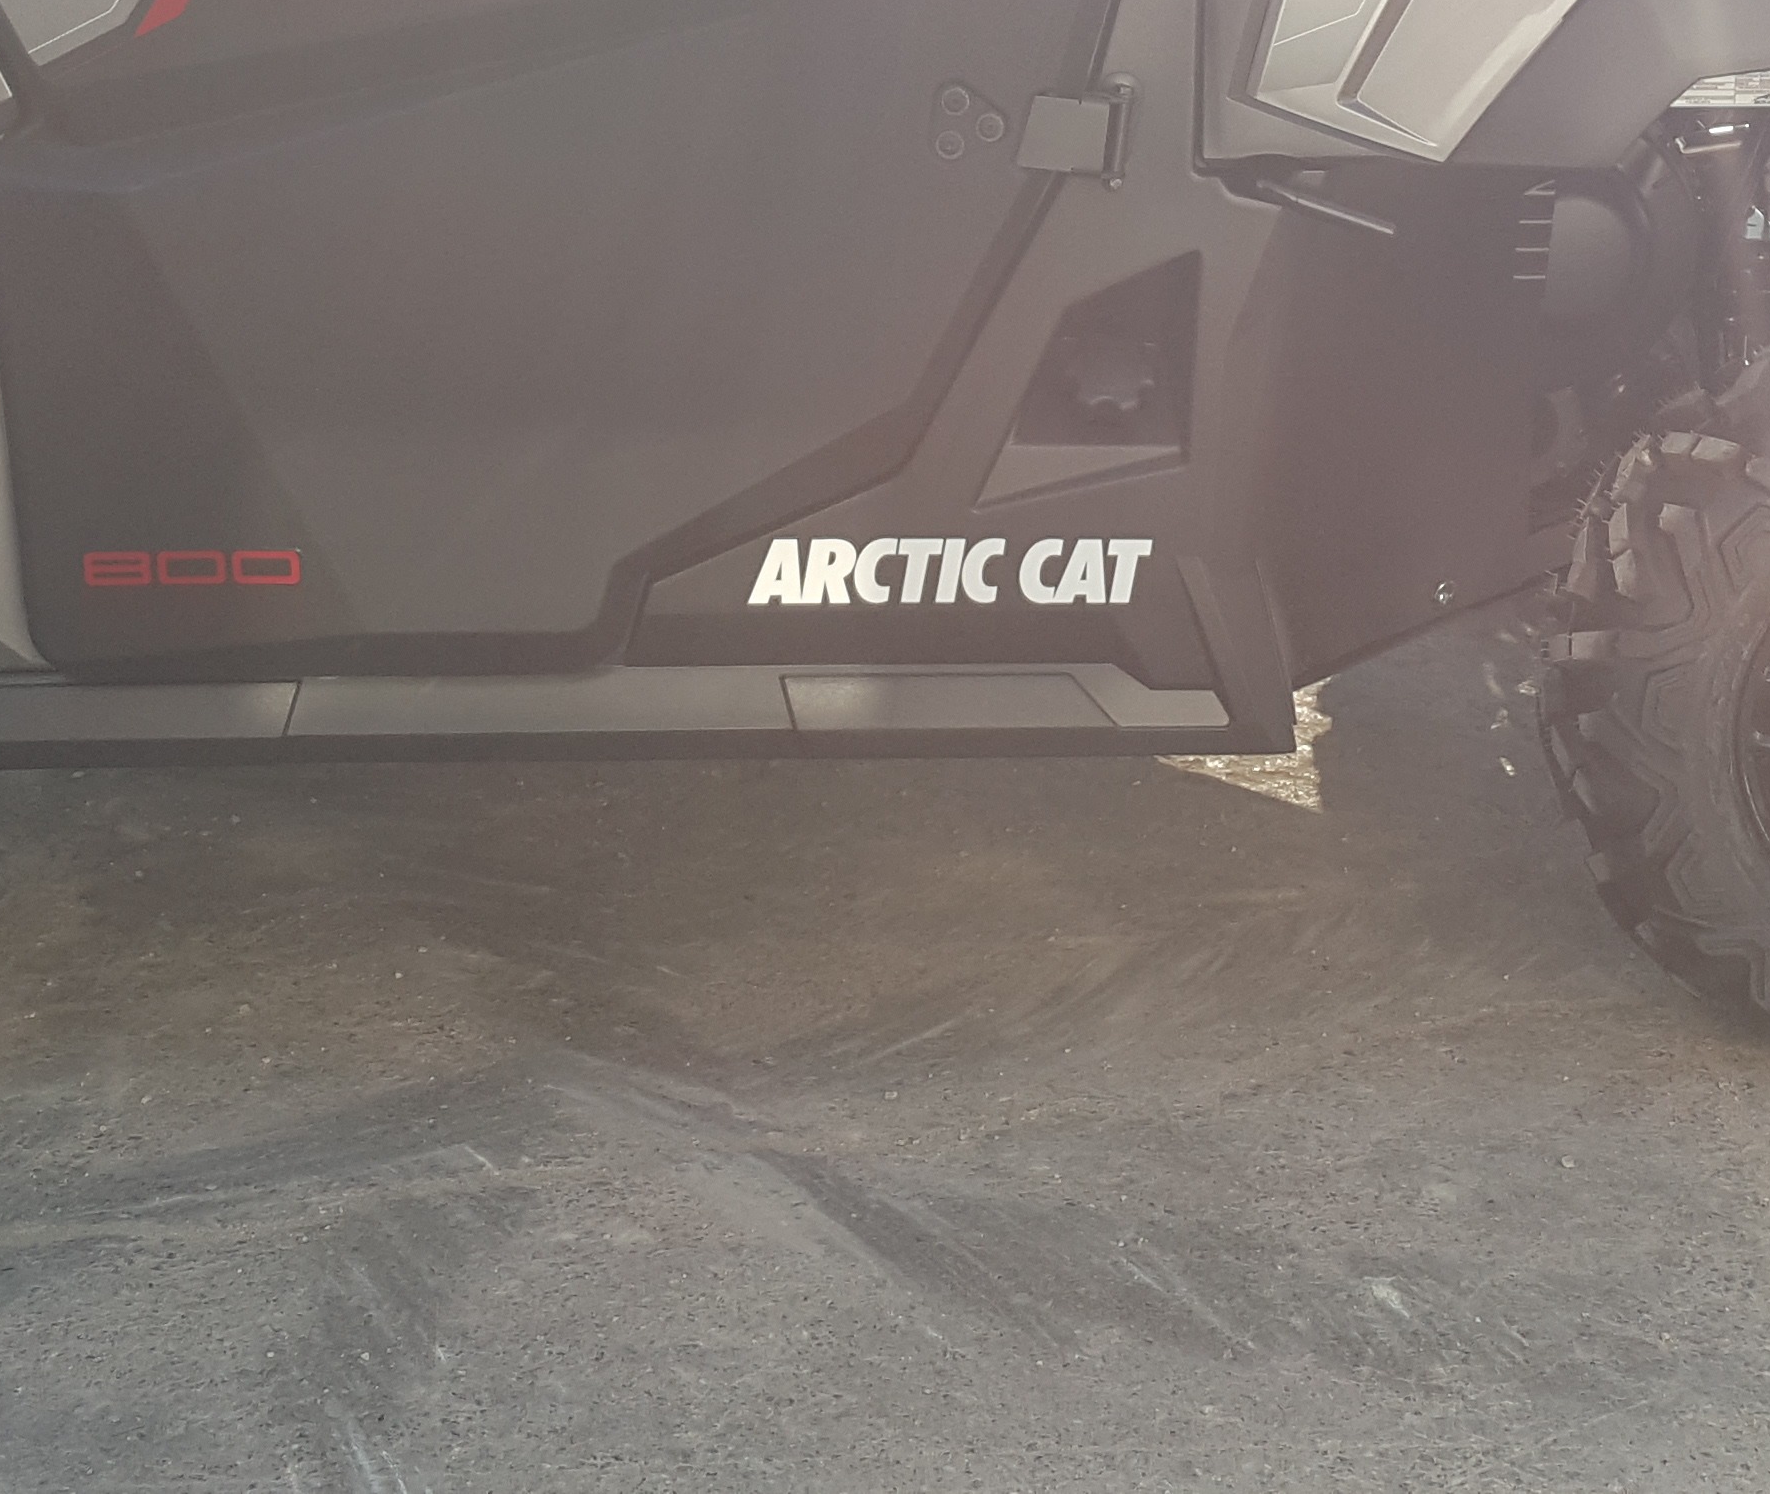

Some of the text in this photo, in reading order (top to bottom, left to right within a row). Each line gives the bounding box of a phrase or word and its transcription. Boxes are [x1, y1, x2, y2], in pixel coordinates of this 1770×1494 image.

[83, 550, 302, 587] 800
[747, 537, 1154, 604] ARCTIC CAT
